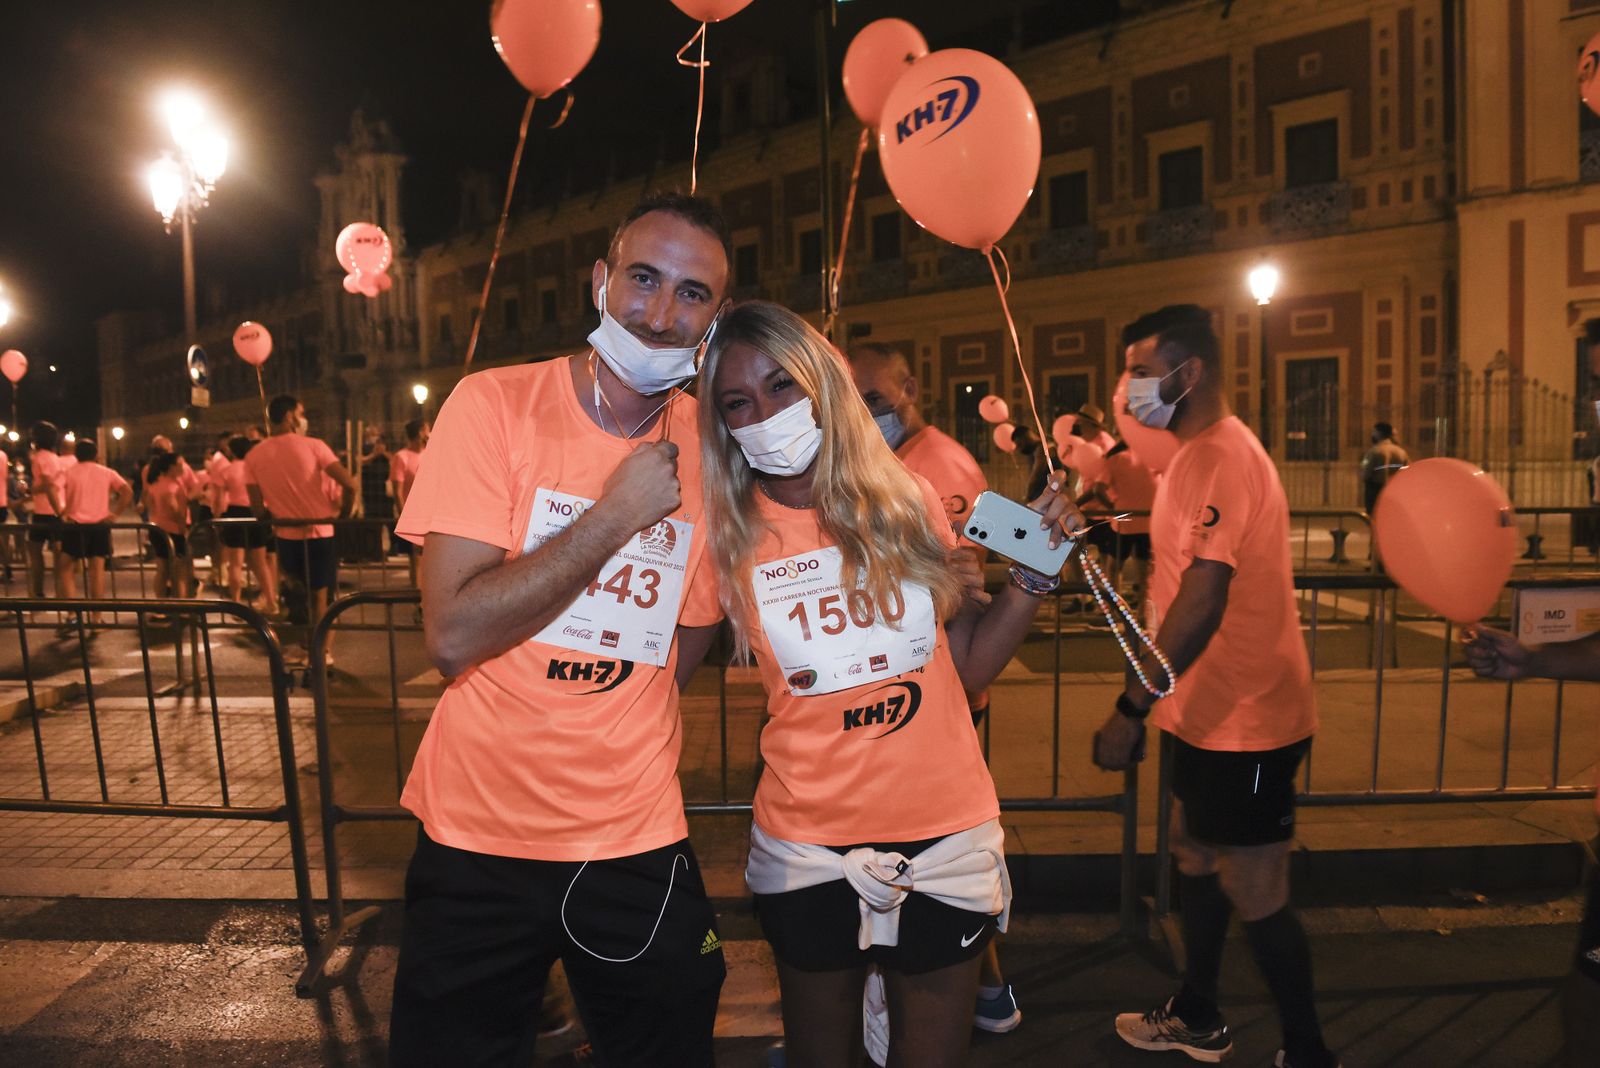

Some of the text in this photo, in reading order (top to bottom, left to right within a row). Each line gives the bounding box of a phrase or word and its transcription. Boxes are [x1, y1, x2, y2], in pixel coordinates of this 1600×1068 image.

[780, 589, 806, 602] CARRERA
[807, 584, 839, 597] NOCTURNA
[788, 578, 905, 641] 1500
[1544, 609, 1566, 620] IMD
[645, 640, 660, 649] ABC
